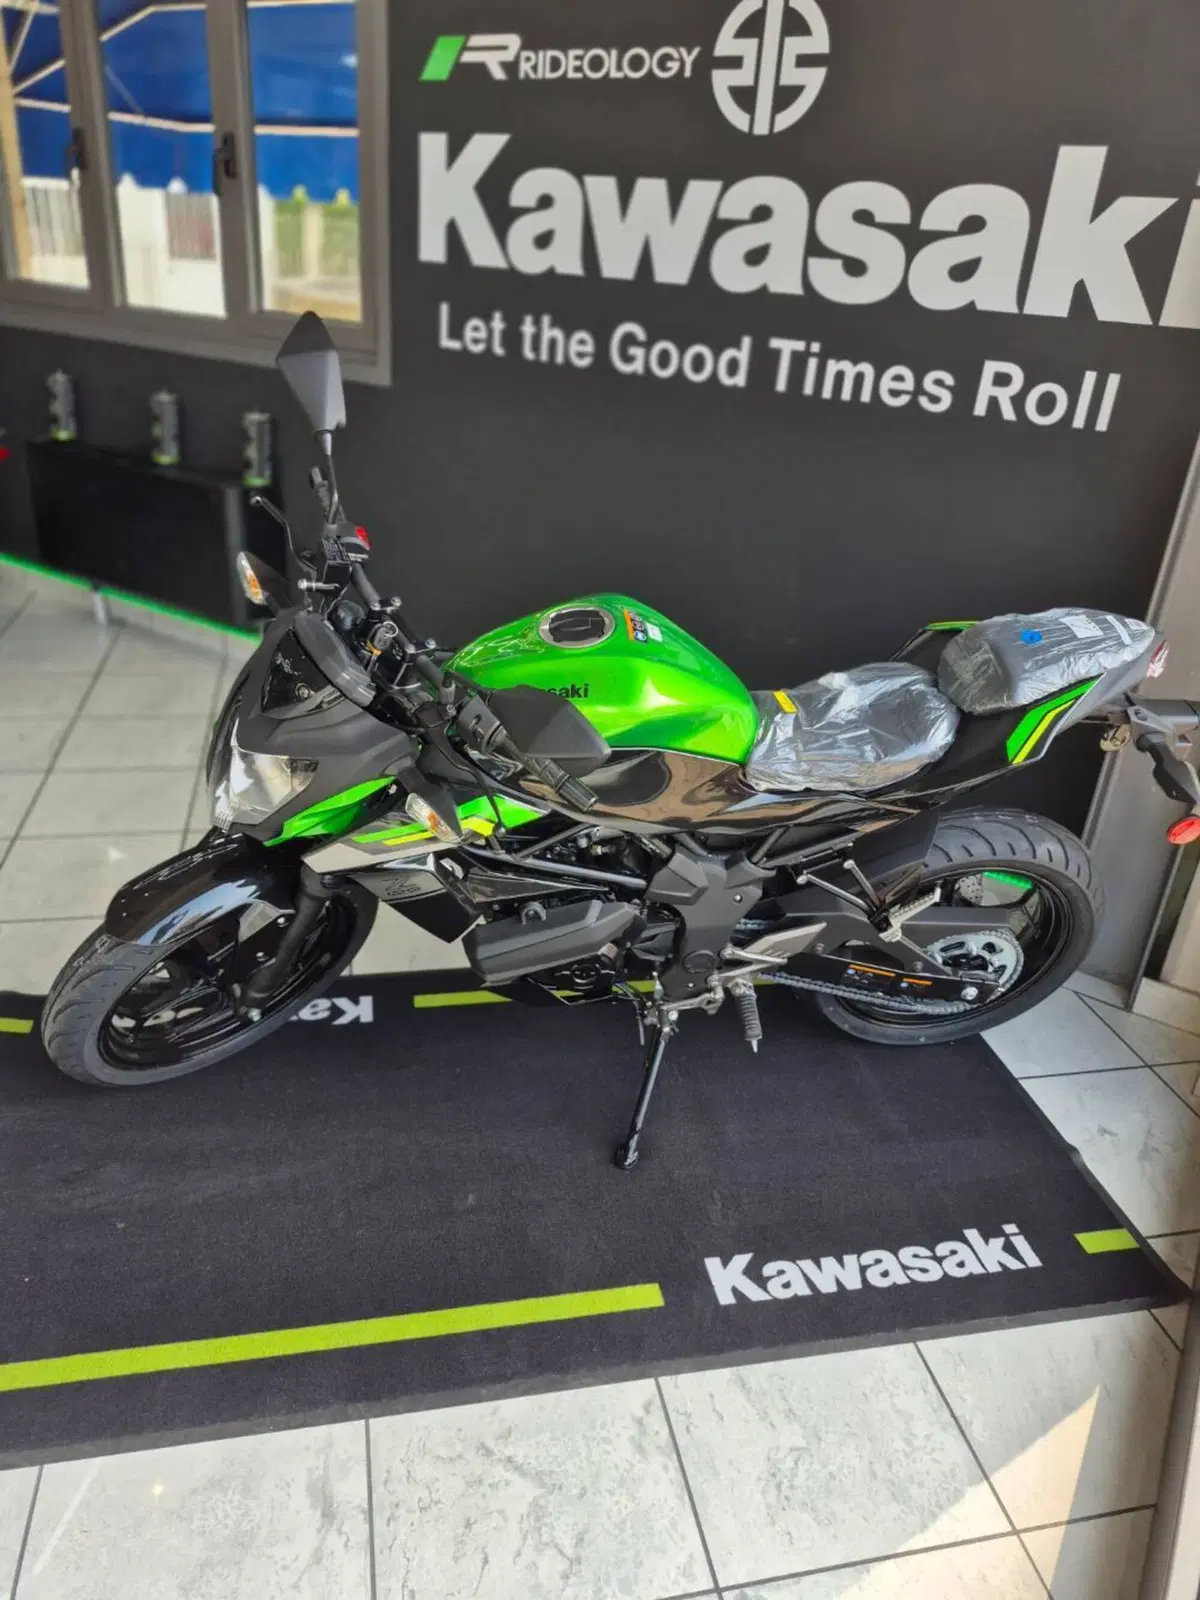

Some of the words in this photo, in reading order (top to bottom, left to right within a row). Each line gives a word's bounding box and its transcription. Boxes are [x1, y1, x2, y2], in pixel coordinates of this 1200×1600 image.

[518, 46, 701, 80] RIDEOLOGY
[438, 302, 505, 356] Let
[520, 315, 595, 368] the
[609, 322, 752, 388] Good
[768, 337, 955, 413] Times
[973, 359, 1121, 432] Roll
[704, 1223, 1043, 1306] Kawasaki
